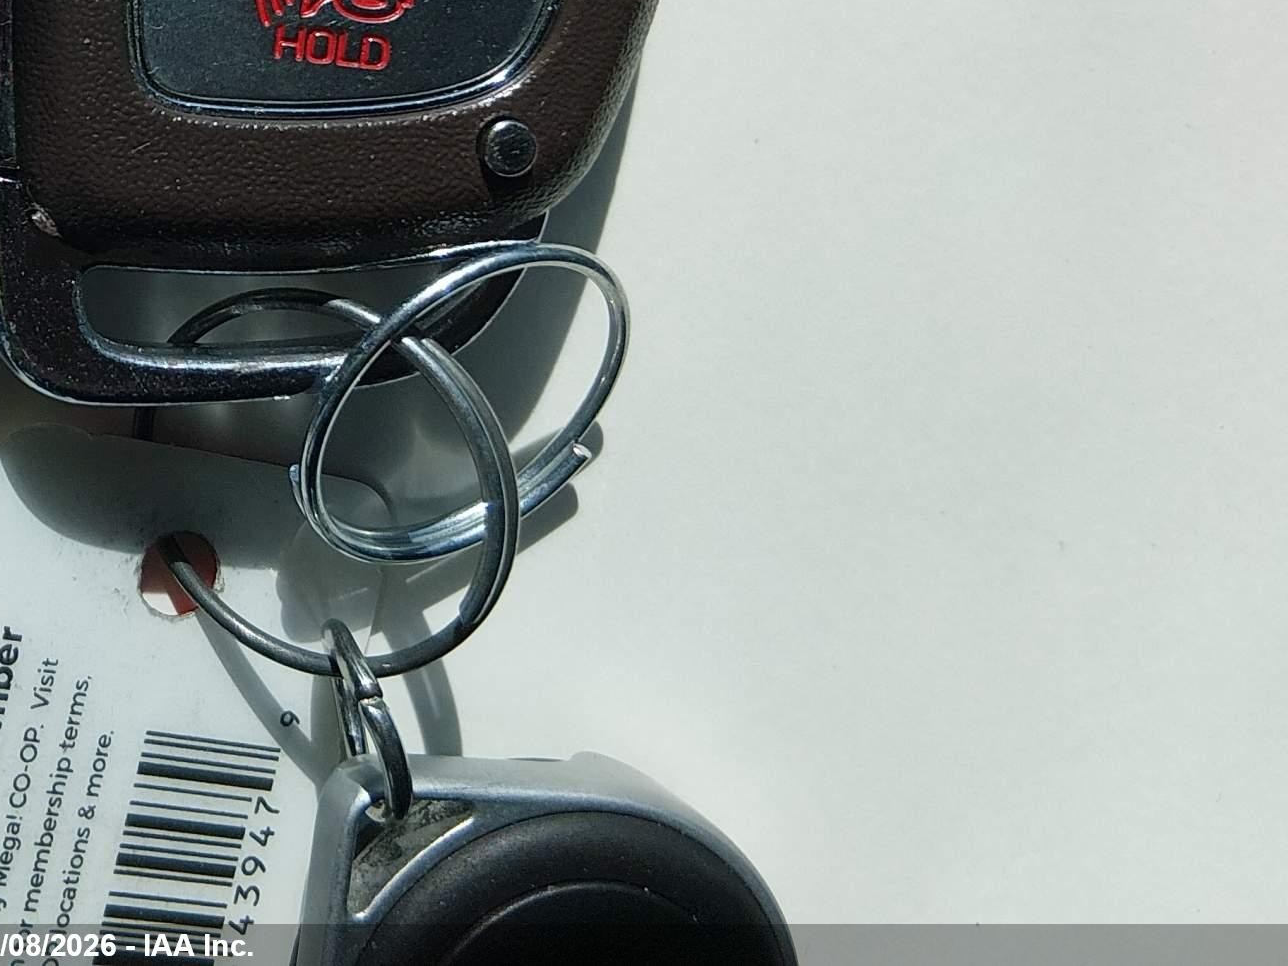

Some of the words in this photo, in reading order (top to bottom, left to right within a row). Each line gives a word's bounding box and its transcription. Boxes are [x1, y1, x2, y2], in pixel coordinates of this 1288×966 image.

[273, 25, 392, 70] HOLD
[9, 724, 44, 808] CO-OP.
[30, 658, 58, 709] Visit
[86, 731, 114, 797] more.
[24, 757, 73, 912] membership
[59, 675, 92, 749] terms,
[78, 805, 96, 820] &
[49, 827, 91, 935] locations
